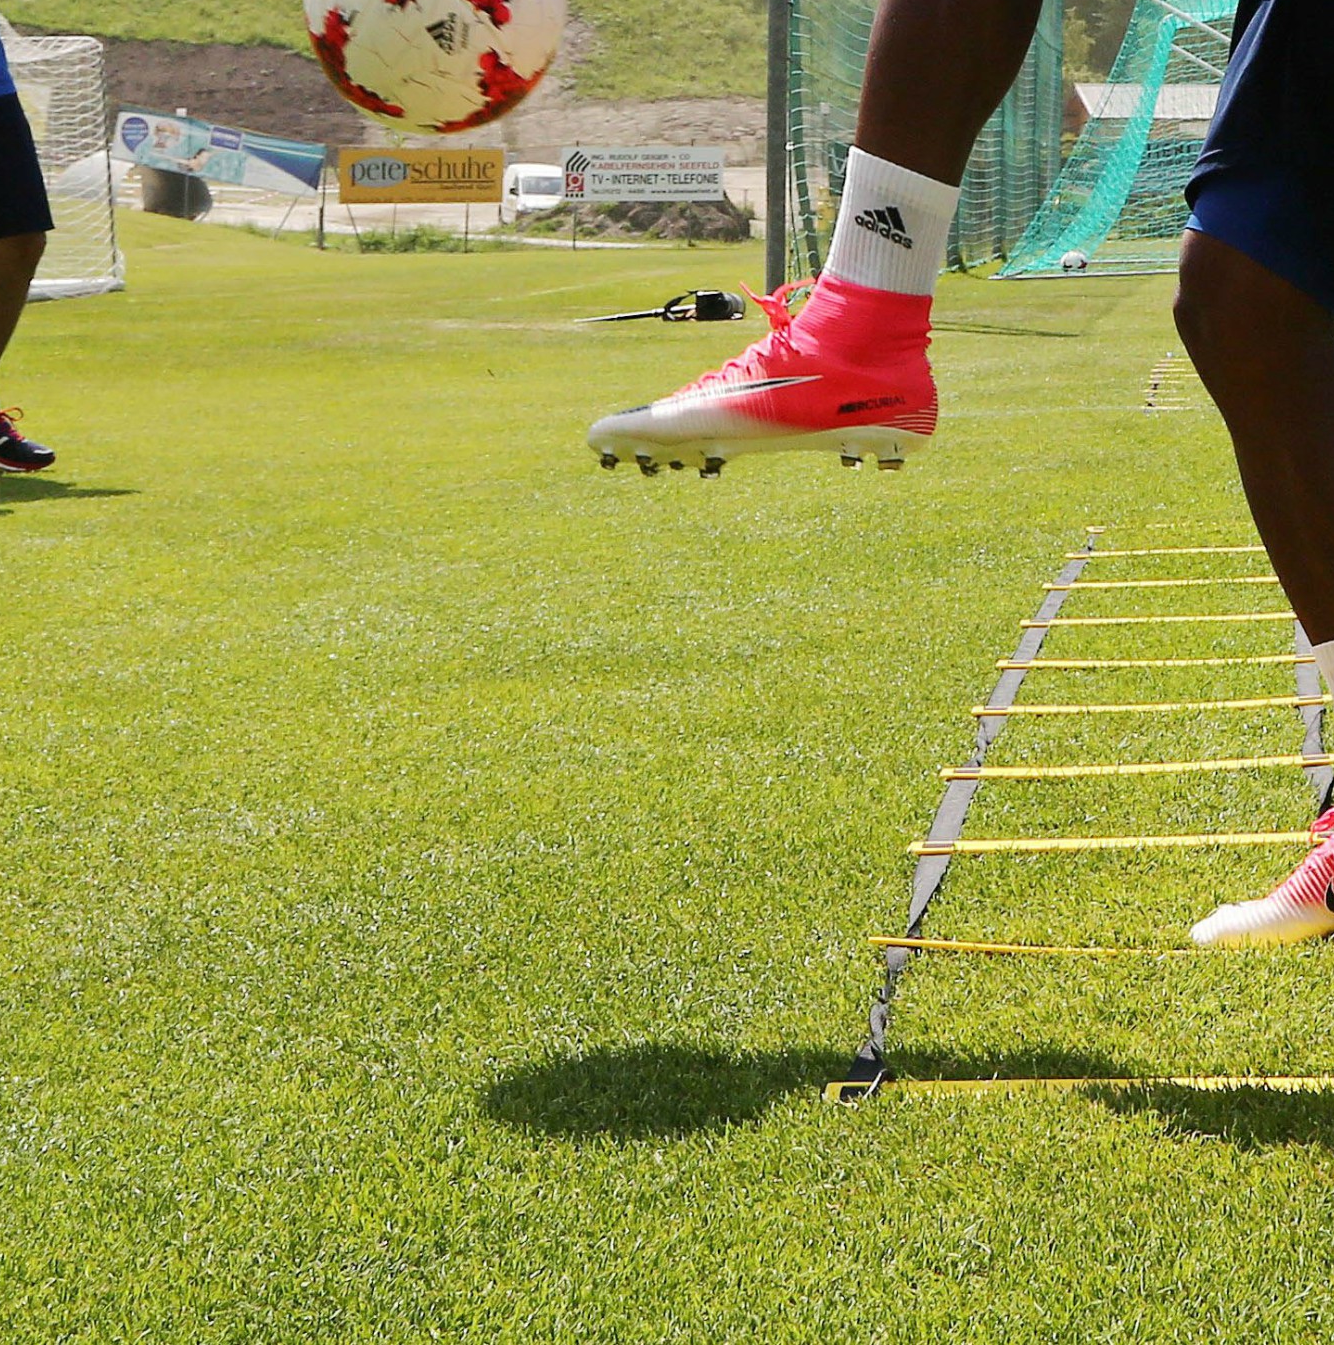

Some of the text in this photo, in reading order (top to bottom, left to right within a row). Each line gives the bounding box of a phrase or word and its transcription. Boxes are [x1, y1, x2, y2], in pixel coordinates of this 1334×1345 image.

[591, 174, 604, 184] TV
[612, 174, 659, 184] INTERNET
[667, 174, 719, 184] TELEFONIE
[854, 214, 913, 249] adidas
